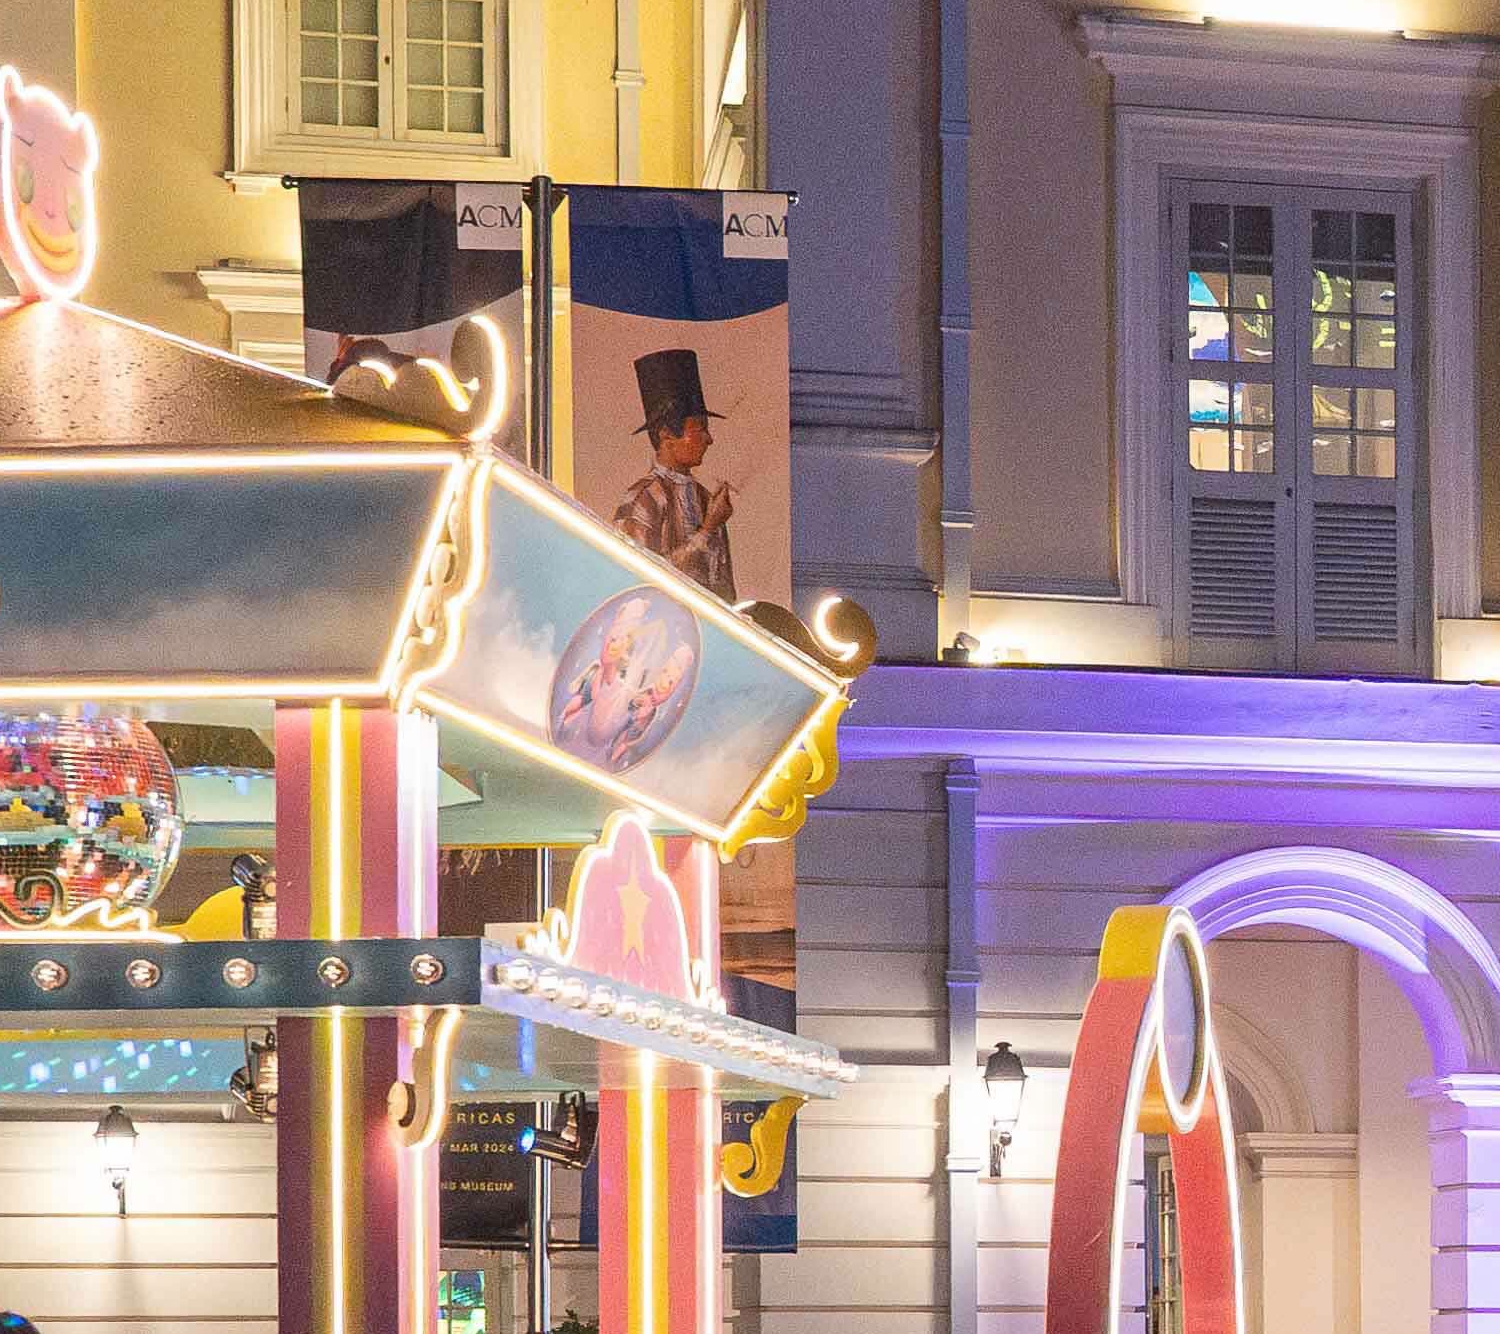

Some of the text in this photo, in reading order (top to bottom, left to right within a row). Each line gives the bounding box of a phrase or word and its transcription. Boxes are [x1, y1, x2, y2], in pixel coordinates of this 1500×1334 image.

[457, 202, 523, 229] ACM
[723, 211, 788, 238] ACM
[456, 1111, 516, 1125] RICAS
[460, 1181, 515, 1192] MUSEUM
